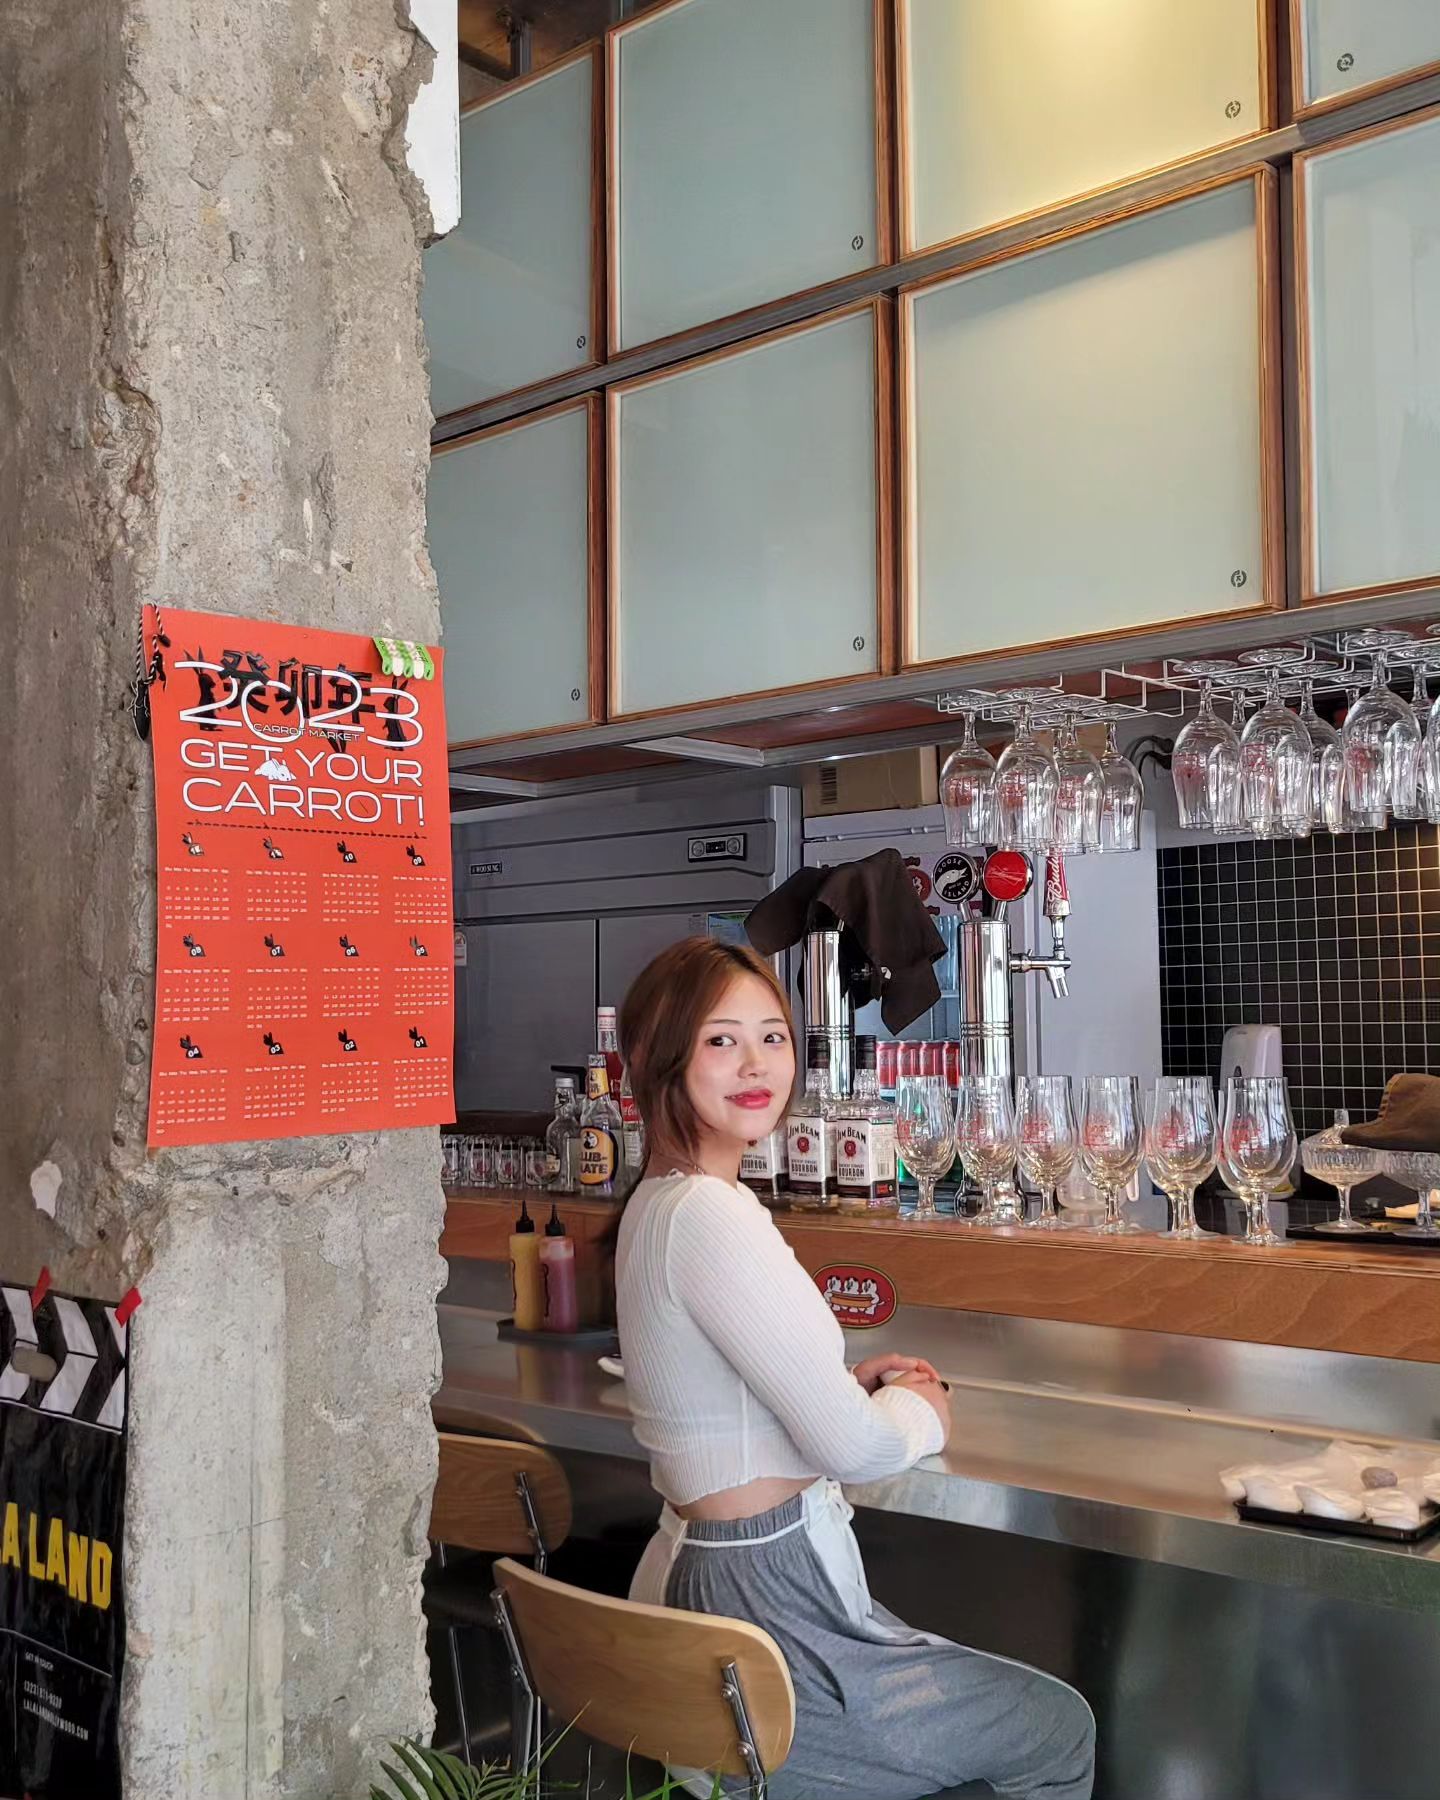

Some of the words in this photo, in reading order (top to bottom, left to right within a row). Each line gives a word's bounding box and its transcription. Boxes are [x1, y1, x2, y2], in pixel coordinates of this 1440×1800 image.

[174, 660, 424, 748] 2023
[253, 722, 306, 736] CARROT
[309, 730, 360, 741] MARKET
[180, 738, 283, 772] GET
[295, 748, 423, 787] YOUR
[182, 777, 425, 826] CARROT!
[344, 852, 354, 862] 10
[413, 856, 422, 866] 09
[938, 858, 962, 873] GOOSE
[944, 880, 970, 898] ISLAND
[271, 946, 281, 956] 07
[346, 946, 356, 956] 06
[270, 1044, 280, 1054] 03
[344, 1040, 355, 1051] 02
[415, 1037, 425, 1048] 01
[188, 1047, 199, 1058] 04
[800, 1122, 820, 1141] BEAM
[848, 1126, 866, 1145] BEAM
[29, 1511, 113, 1611] LAND
